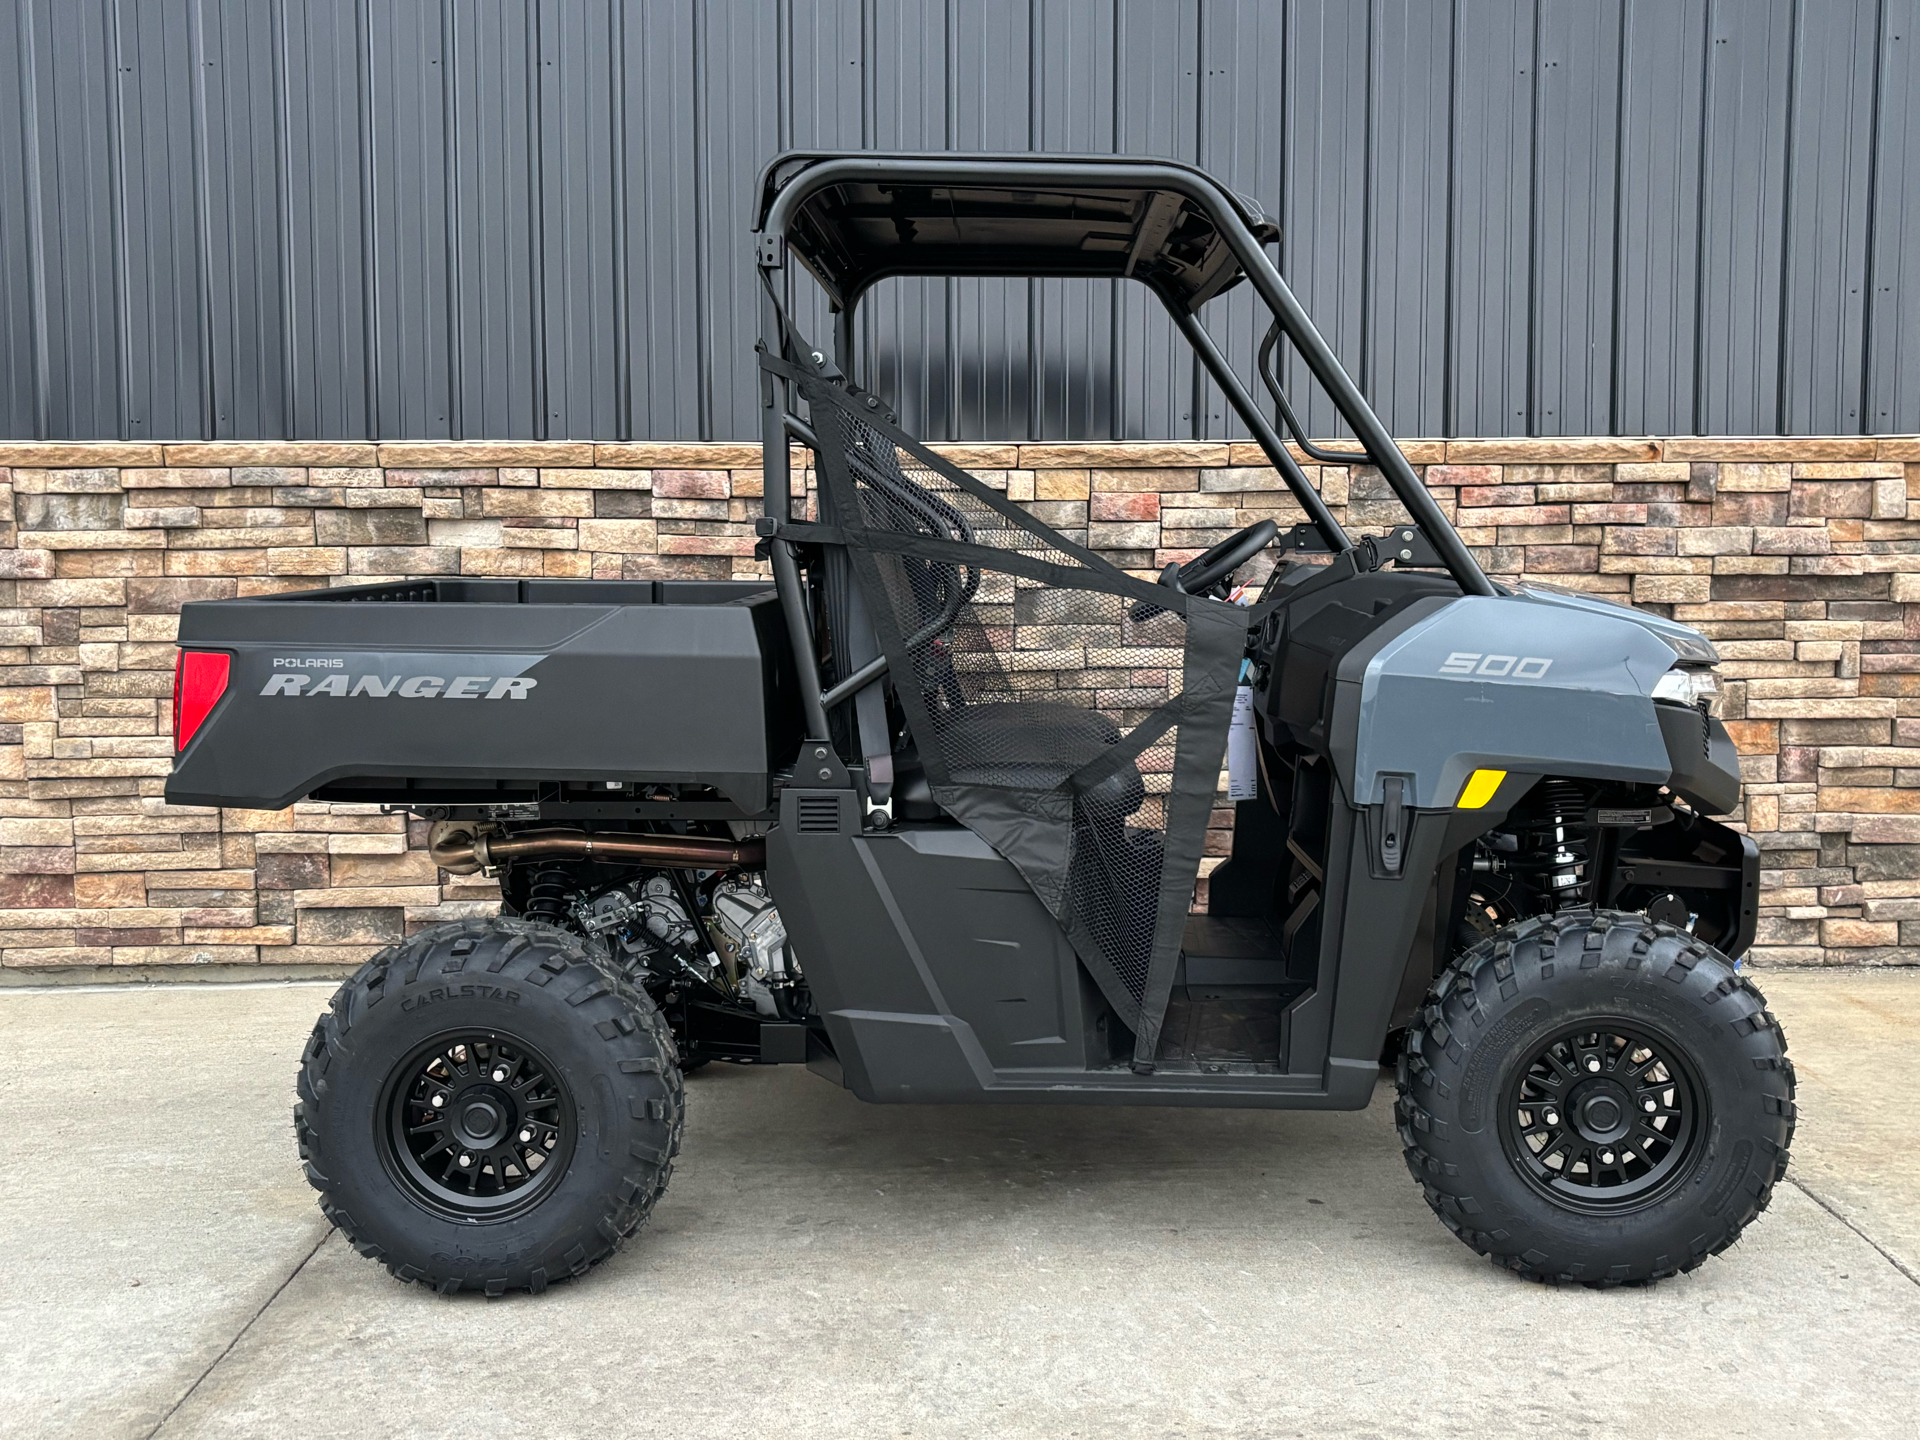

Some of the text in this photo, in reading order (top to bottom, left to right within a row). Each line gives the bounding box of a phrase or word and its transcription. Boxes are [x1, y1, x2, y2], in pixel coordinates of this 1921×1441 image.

[273, 658, 344, 668] POLARIS
[1438, 652, 1553, 679] 500
[259, 673, 538, 700] RANGER
[401, 985, 521, 1012] CARLSTAR
